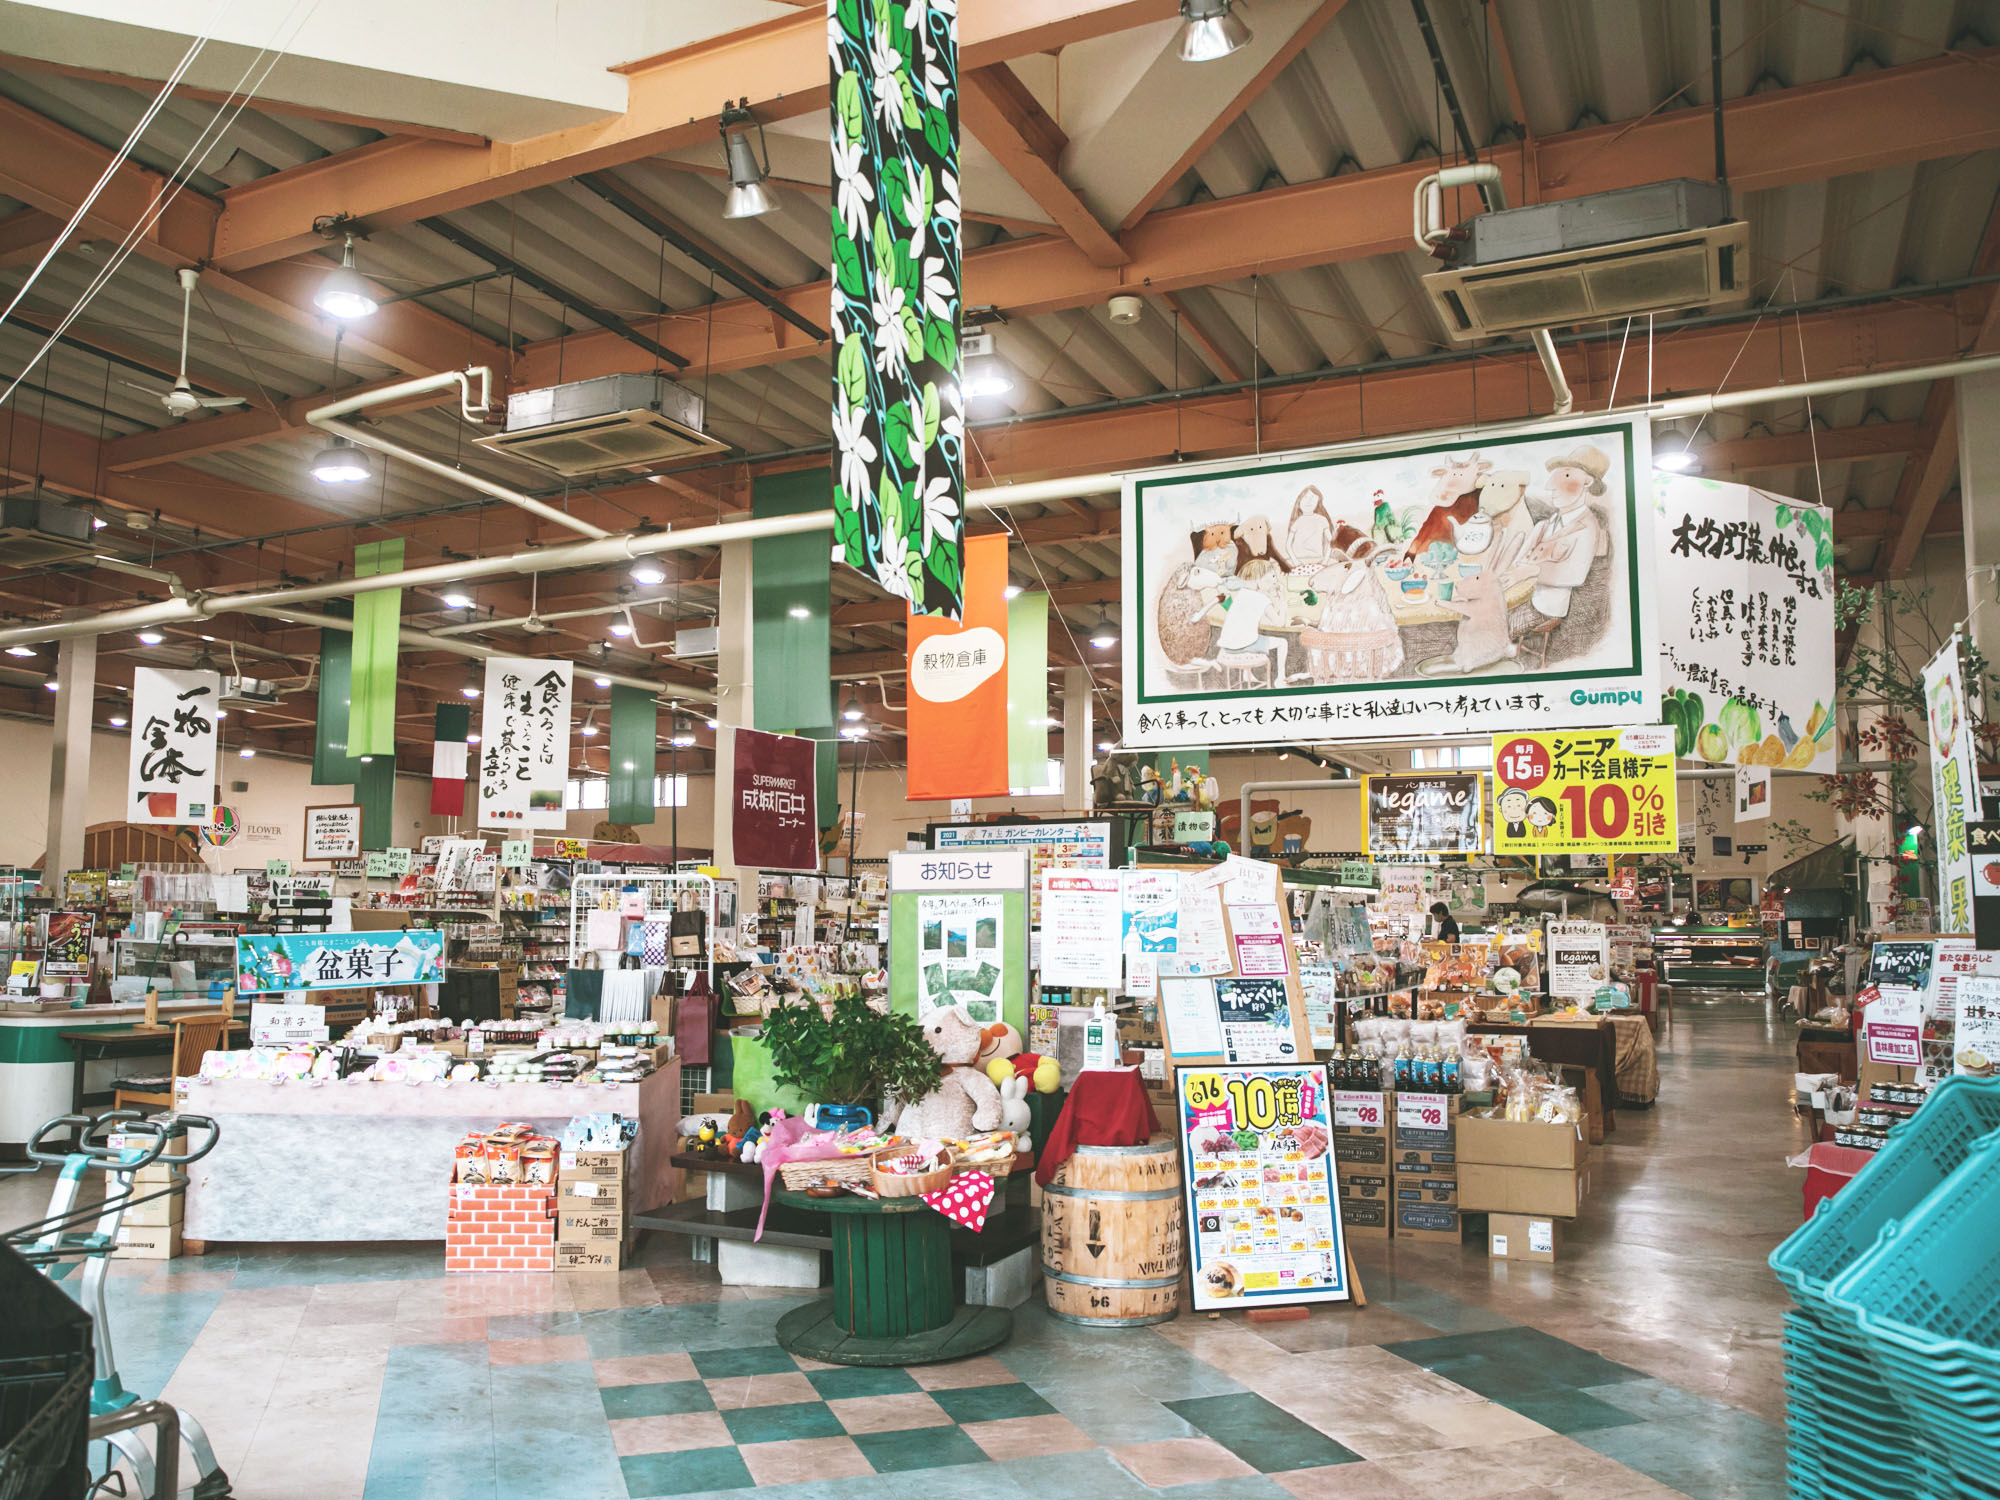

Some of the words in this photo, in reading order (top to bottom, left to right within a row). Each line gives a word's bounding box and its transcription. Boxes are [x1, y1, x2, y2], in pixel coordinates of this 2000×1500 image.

[923, 648, 987, 671] 穀物倉庫
[1570, 689, 1642, 706] Gumpy
[174, 686, 212, 738] 一物
[534, 670, 566, 765] 食べることは
[516, 691, 534, 781] 生きること
[1515, 744, 1533, 755] 毎月
[1553, 738, 1615, 758] シニア
[483, 746, 500, 799] 喜び
[1502, 755, 1544, 780] 15日
[1553, 757, 1667, 780] カード会員様デー
[752, 774, 796, 790] SUPERMARKET
[742, 788, 806, 815] 成城石井
[1381, 786, 1468, 817] legame
[1559, 783, 1629, 839] 10
[1632, 784, 1664, 811] %
[1942, 757, 1966, 865] 野菜
[247, 825, 281, 835] FLOWER
[779, 817, 806, 828] コーナー
[1178, 821, 1198, 832] 漬物
[1634, 812, 1666, 837] 引き
[921, 861, 993, 881] お知らせ
[315, 948, 403, 981] 盆菓子
[1560, 952, 1597, 964] legame
[1875, 950, 1930, 972] ブルーベリー
[1939, 953, 1993, 963] 新たな暮らしと
[1952, 963, 1978, 972] 食生活
[1221, 986, 1284, 1010] ブルーベリー
[1252, 1002, 1266, 1012] 狩り
[269, 1016, 307, 1027] 和菓子
[1228, 1077, 1276, 1129] 10
[1275, 1087, 1299, 1116] 倍
[1278, 1114, 1302, 1126] セール
[1358, 1107, 1378, 1123] 98
[1421, 1108, 1441, 1125] 98
[1271, 1140, 1301, 1152] 但馬牛
[576, 1157, 608, 1167] だんご粉
[576, 1217, 608, 1228] だんご粉
[569, 1255, 602, 1265] だんご粉
[1091, 1296, 1111, 1308] 94
